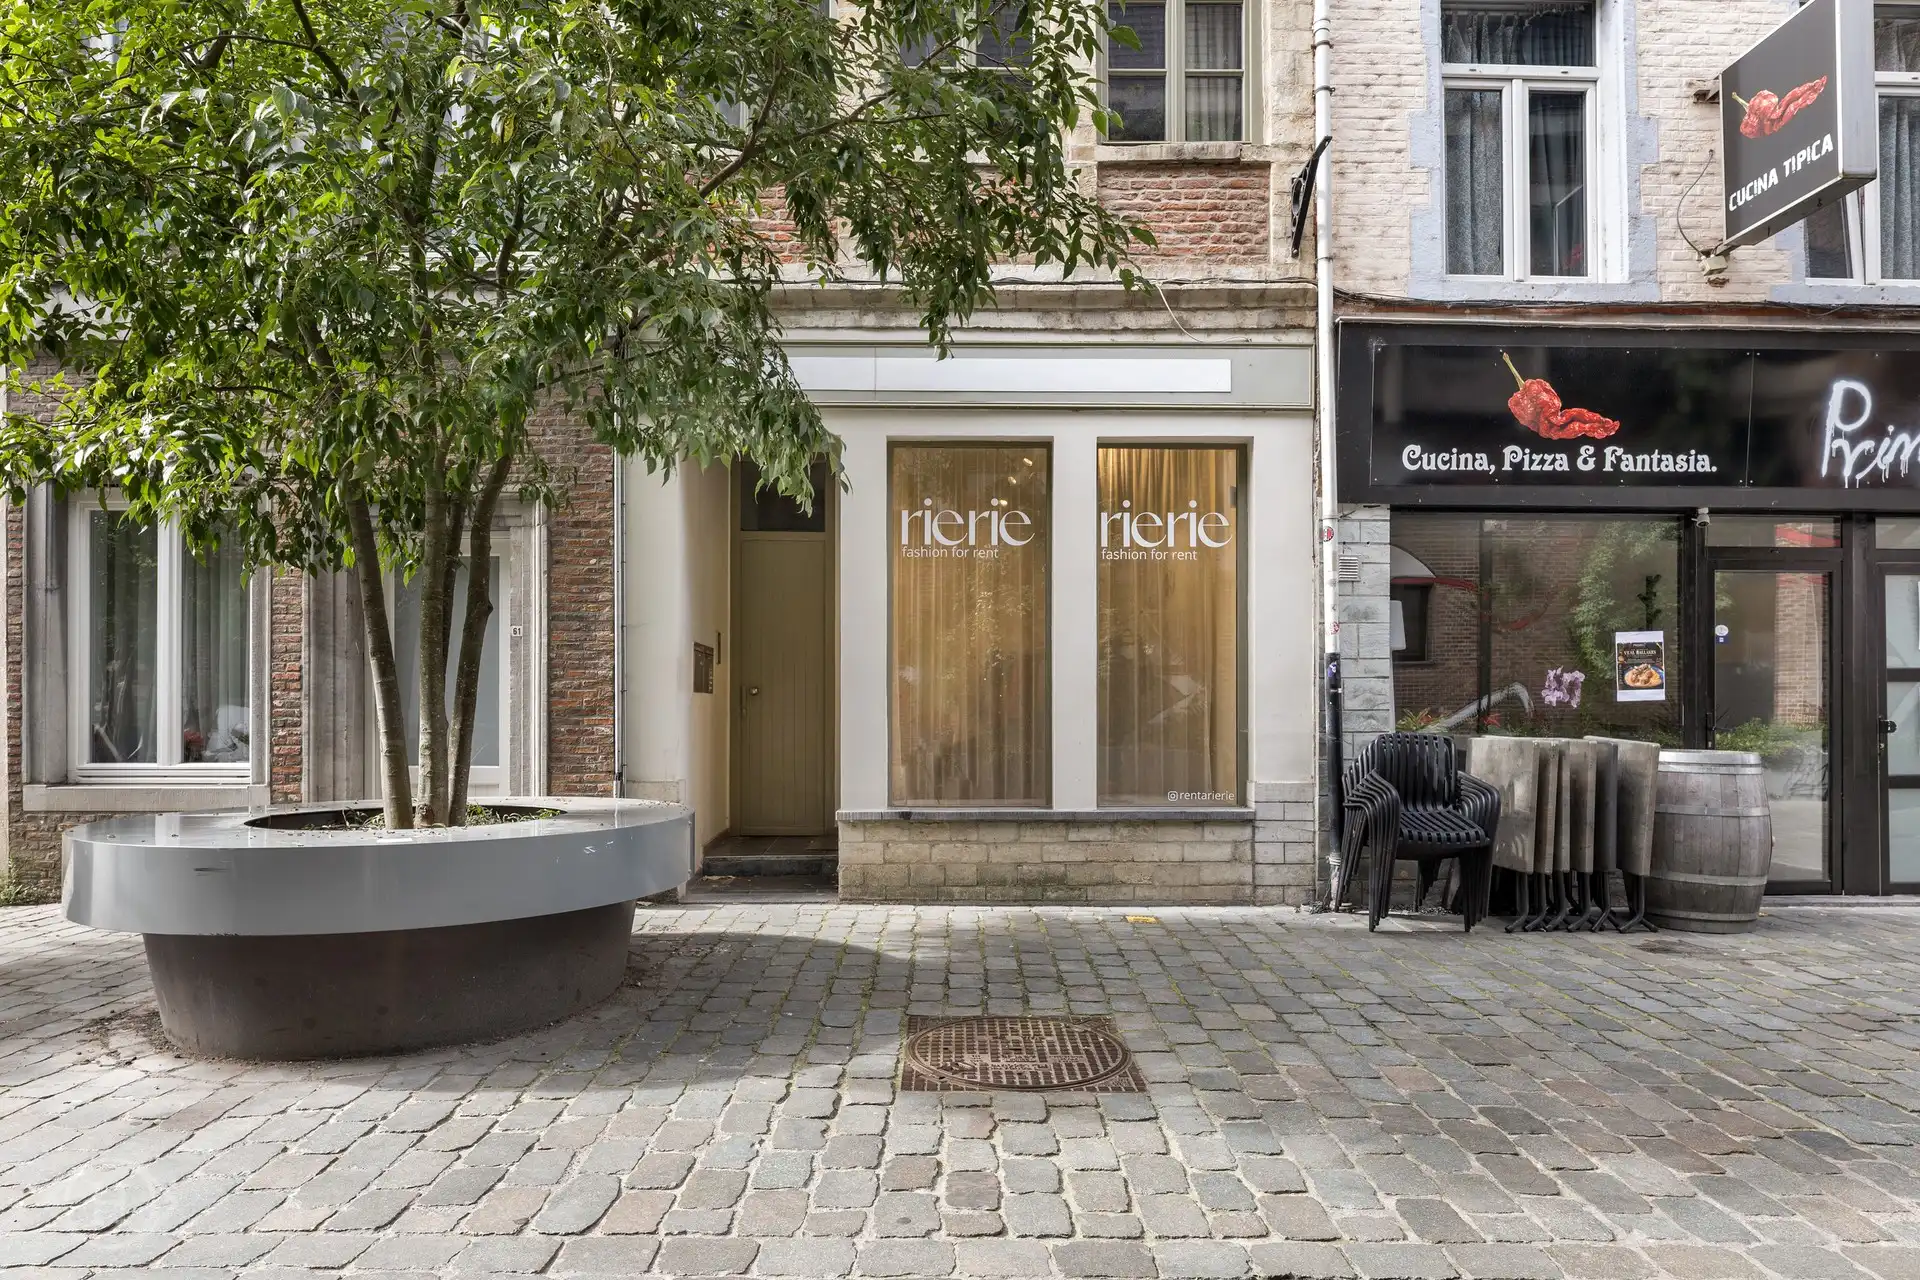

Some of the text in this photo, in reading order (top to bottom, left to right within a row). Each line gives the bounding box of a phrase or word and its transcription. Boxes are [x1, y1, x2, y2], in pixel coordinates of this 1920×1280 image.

[1728, 133, 1834, 212] CUCINA TIPICA
[1402, 444, 1717, 474] Cucina, Pizza & Fantasia.
[901, 498, 1036, 546] rierie
[1100, 500, 1233, 548] rierie
[902, 546, 999, 559] fashion for rent
[1101, 548, 1198, 561] fashion for rent
[512, 627, 521, 636] 61
[1180, 790, 1235, 801] rentarierie
